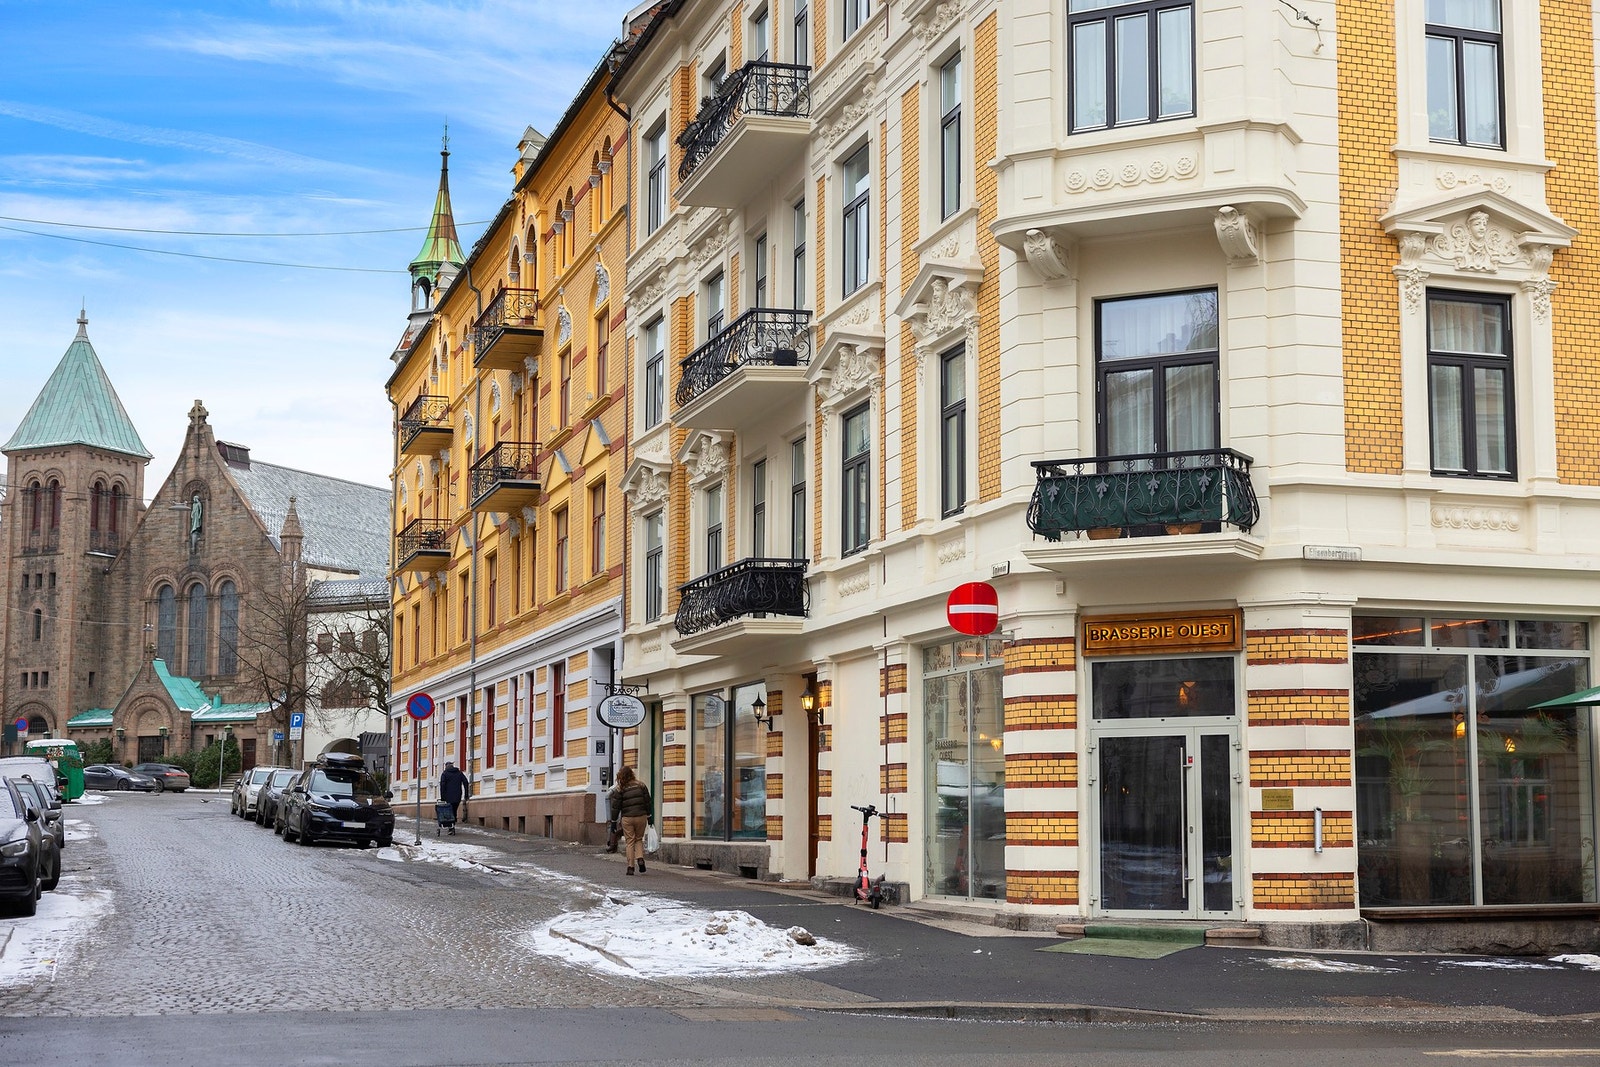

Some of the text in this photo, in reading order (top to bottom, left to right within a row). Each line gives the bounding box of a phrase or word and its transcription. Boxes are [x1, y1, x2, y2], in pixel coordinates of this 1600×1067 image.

[1090, 623, 1229, 641] BRASSERIE OUEST
[293, 715, 301, 726] P
